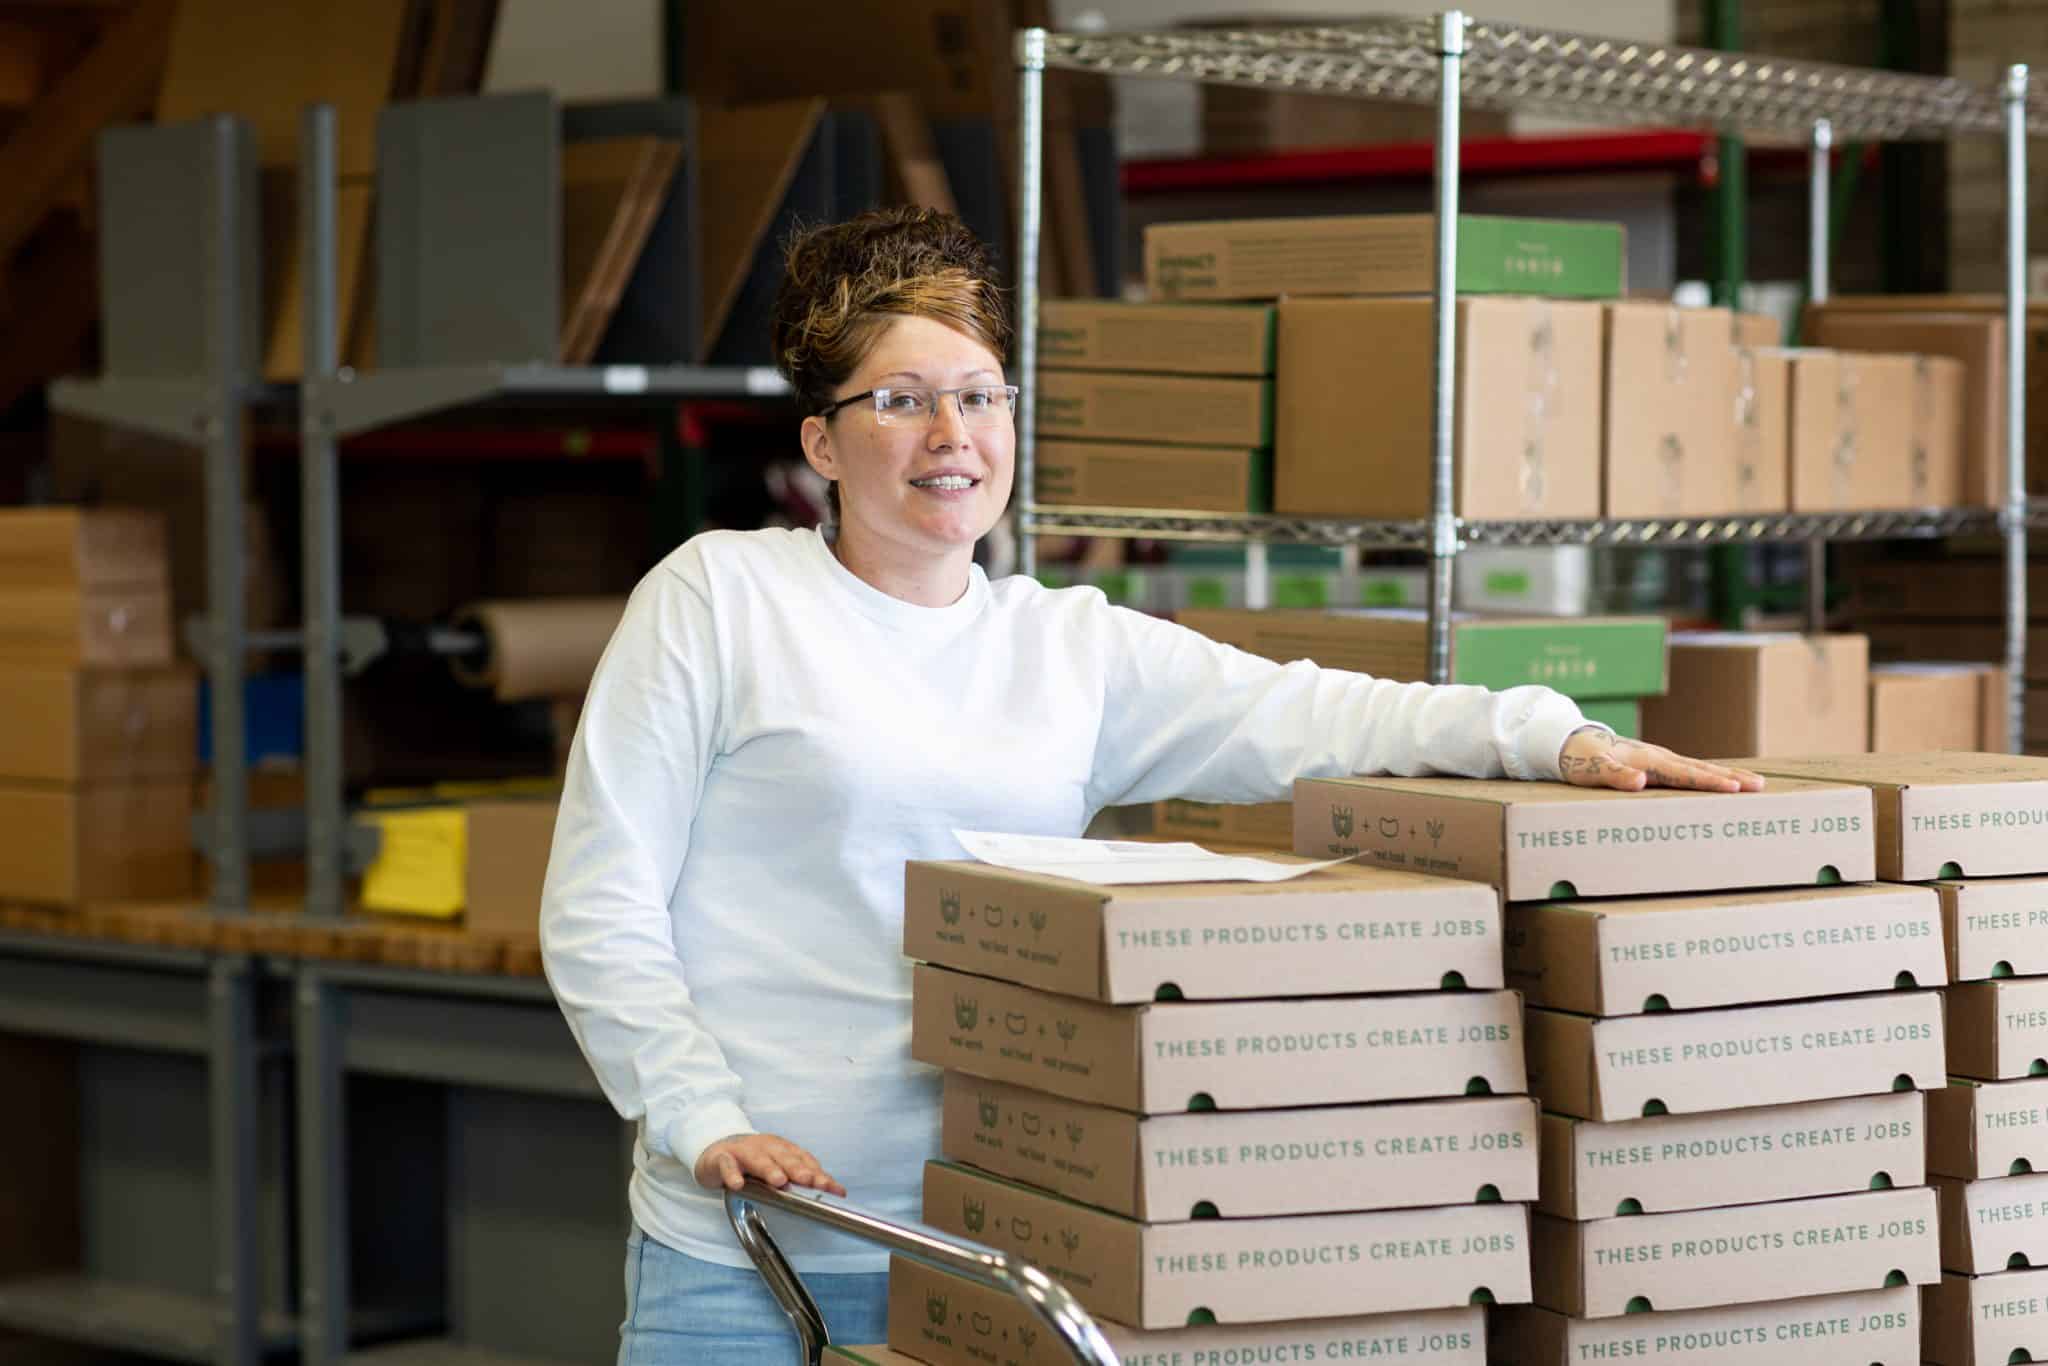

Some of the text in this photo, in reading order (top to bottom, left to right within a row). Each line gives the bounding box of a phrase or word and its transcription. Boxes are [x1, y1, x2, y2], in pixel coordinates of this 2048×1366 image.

[1517, 817, 1861, 848] THESE PRODUCTS CREATE JOBS
[1911, 810, 2048, 832] THESE PRODU
[1118, 920, 1486, 948] THESE PRODUCTS CREATE JOBS
[1967, 913, 2021, 931] THESE
[1610, 921, 1931, 963] THESE PRODUCTS CREATE JOBS
[1154, 1025, 1510, 1057] THESE PRODUCTS CREATE JOBS
[1607, 1024, 1931, 1068] THESE PRODUCTS CREATE JOBS
[1984, 1110, 2039, 1129] THESE
[1155, 1133, 1523, 1168] THESE PRODUCTS CREATE JOBS
[1586, 1122, 1912, 1168] THESE PRODUCTS CREATE JOBS
[1977, 1204, 2033, 1225] THESE
[1155, 1235, 1515, 1273] THESE PRODUCTS CREATE JOBS
[1594, 1220, 1926, 1266] THESE PRODUCTS CREATE JOBS
[1981, 1299, 2038, 1320] THESE
[1124, 1334, 1472, 1366] HESE PRODUCTS CREATE JOBS
[1579, 1313, 1907, 1360] THESE PRODUCTS CREATE JOBS
